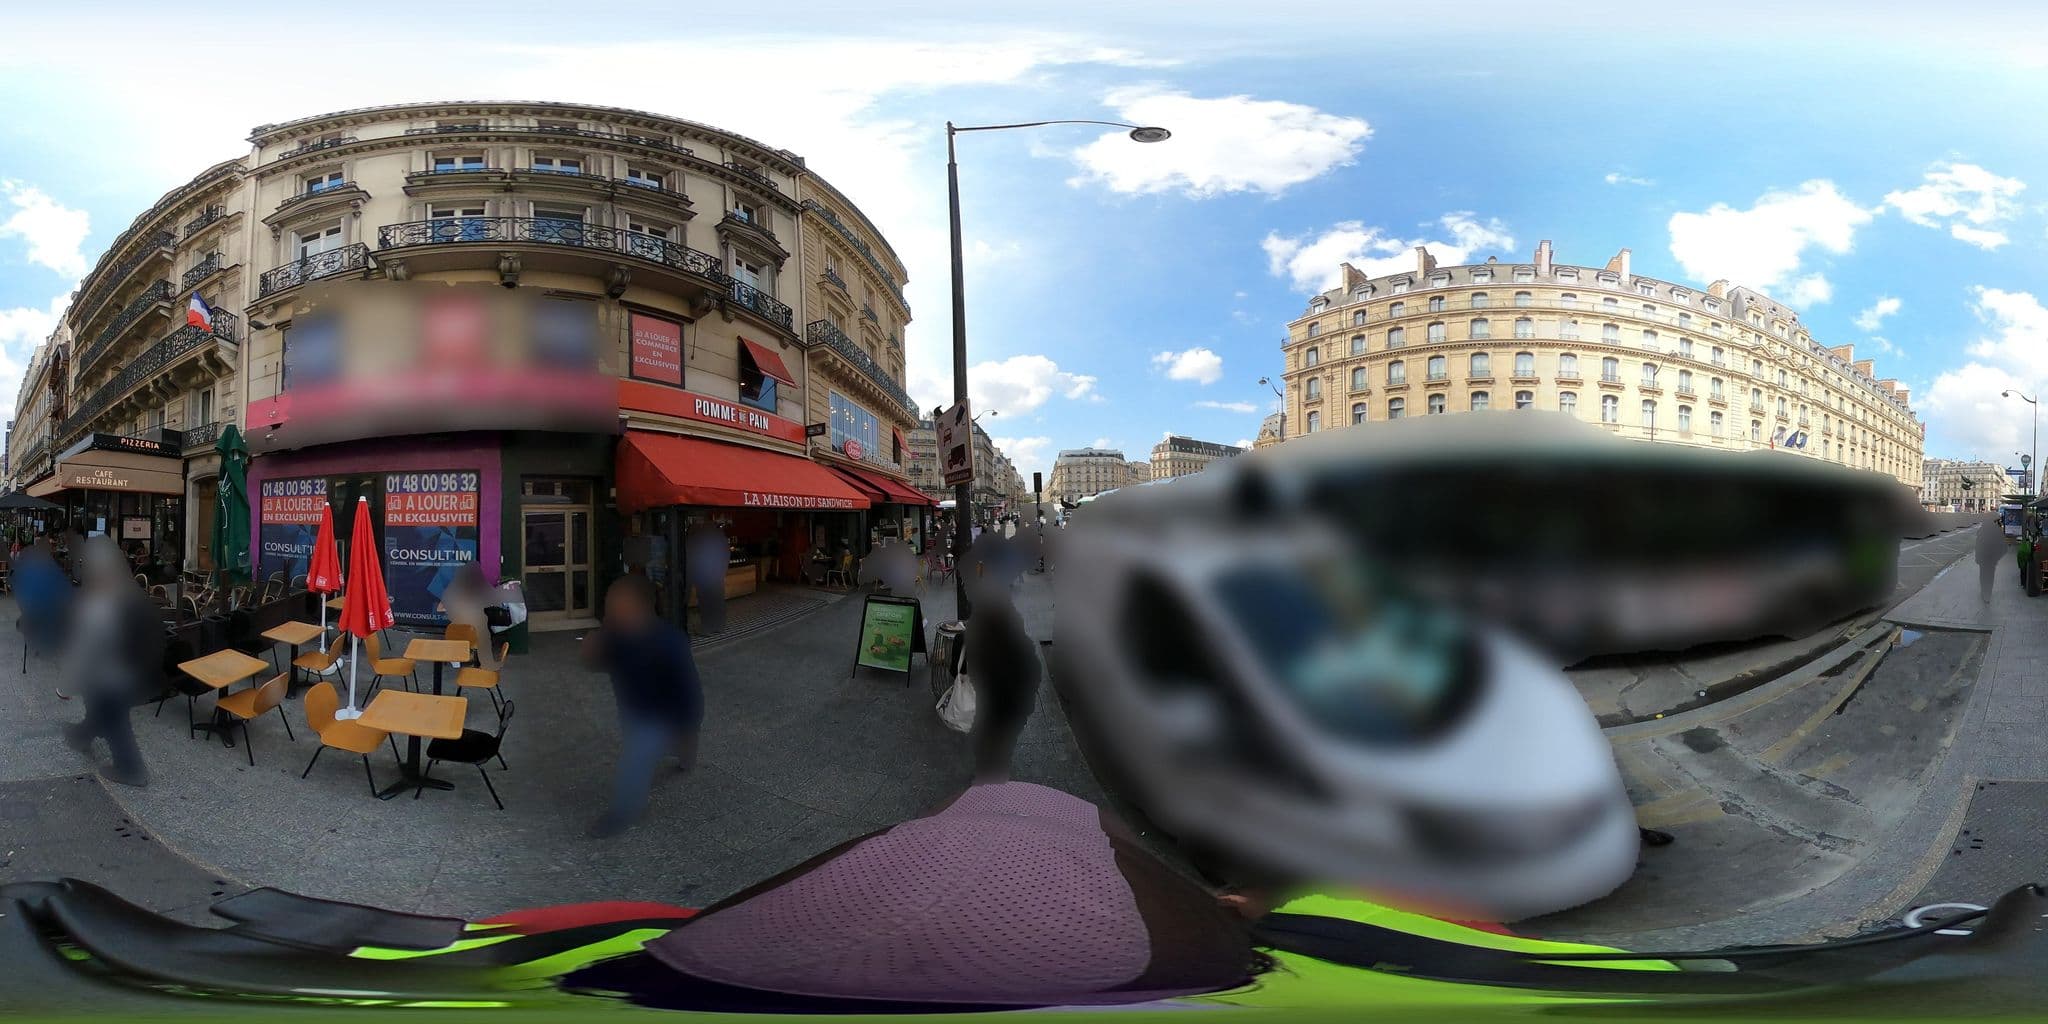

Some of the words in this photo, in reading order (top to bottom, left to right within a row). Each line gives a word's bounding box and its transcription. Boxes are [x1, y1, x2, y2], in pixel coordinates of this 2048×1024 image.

[650, 332, 670, 344] LOUER
[636, 338, 677, 353] COMMERCE
[652, 350, 663, 358] EN
[635, 356, 680, 372] EXCLUSIVITE
[695, 398, 737, 422] POMME
[749, 412, 769, 430] PAIN
[120, 437, 160, 449] PIZZERIA
[94, 470, 113, 478] CAFE
[76, 476, 128, 487] RESTAURANT
[263, 482, 272, 497] 01
[273, 481, 285, 497] 48
[286, 480, 298, 496] 00
[300, 479, 312, 495] 96
[314, 478, 327, 495] 32
[386, 475, 400, 493] 01
[402, 474, 418, 493] 48
[421, 473, 438, 492] 00
[441, 473, 457, 492] 96
[460, 472, 477, 492] 32
[284, 497, 312, 511] LOUER
[418, 495, 458, 510] LOUER
[744, 492, 760, 505] LA
[762, 494, 802, 508] MAISON
[804, 497, 816, 508] DU
[817, 497, 853, 509] SANDWICH
[263, 513, 273, 521] EN
[388, 513, 402, 522] EN
[405, 513, 474, 523] EXCLUSIVITE
[264, 542, 315, 555] CONSULT'I
[390, 549, 472, 561] CONSULT'IM
